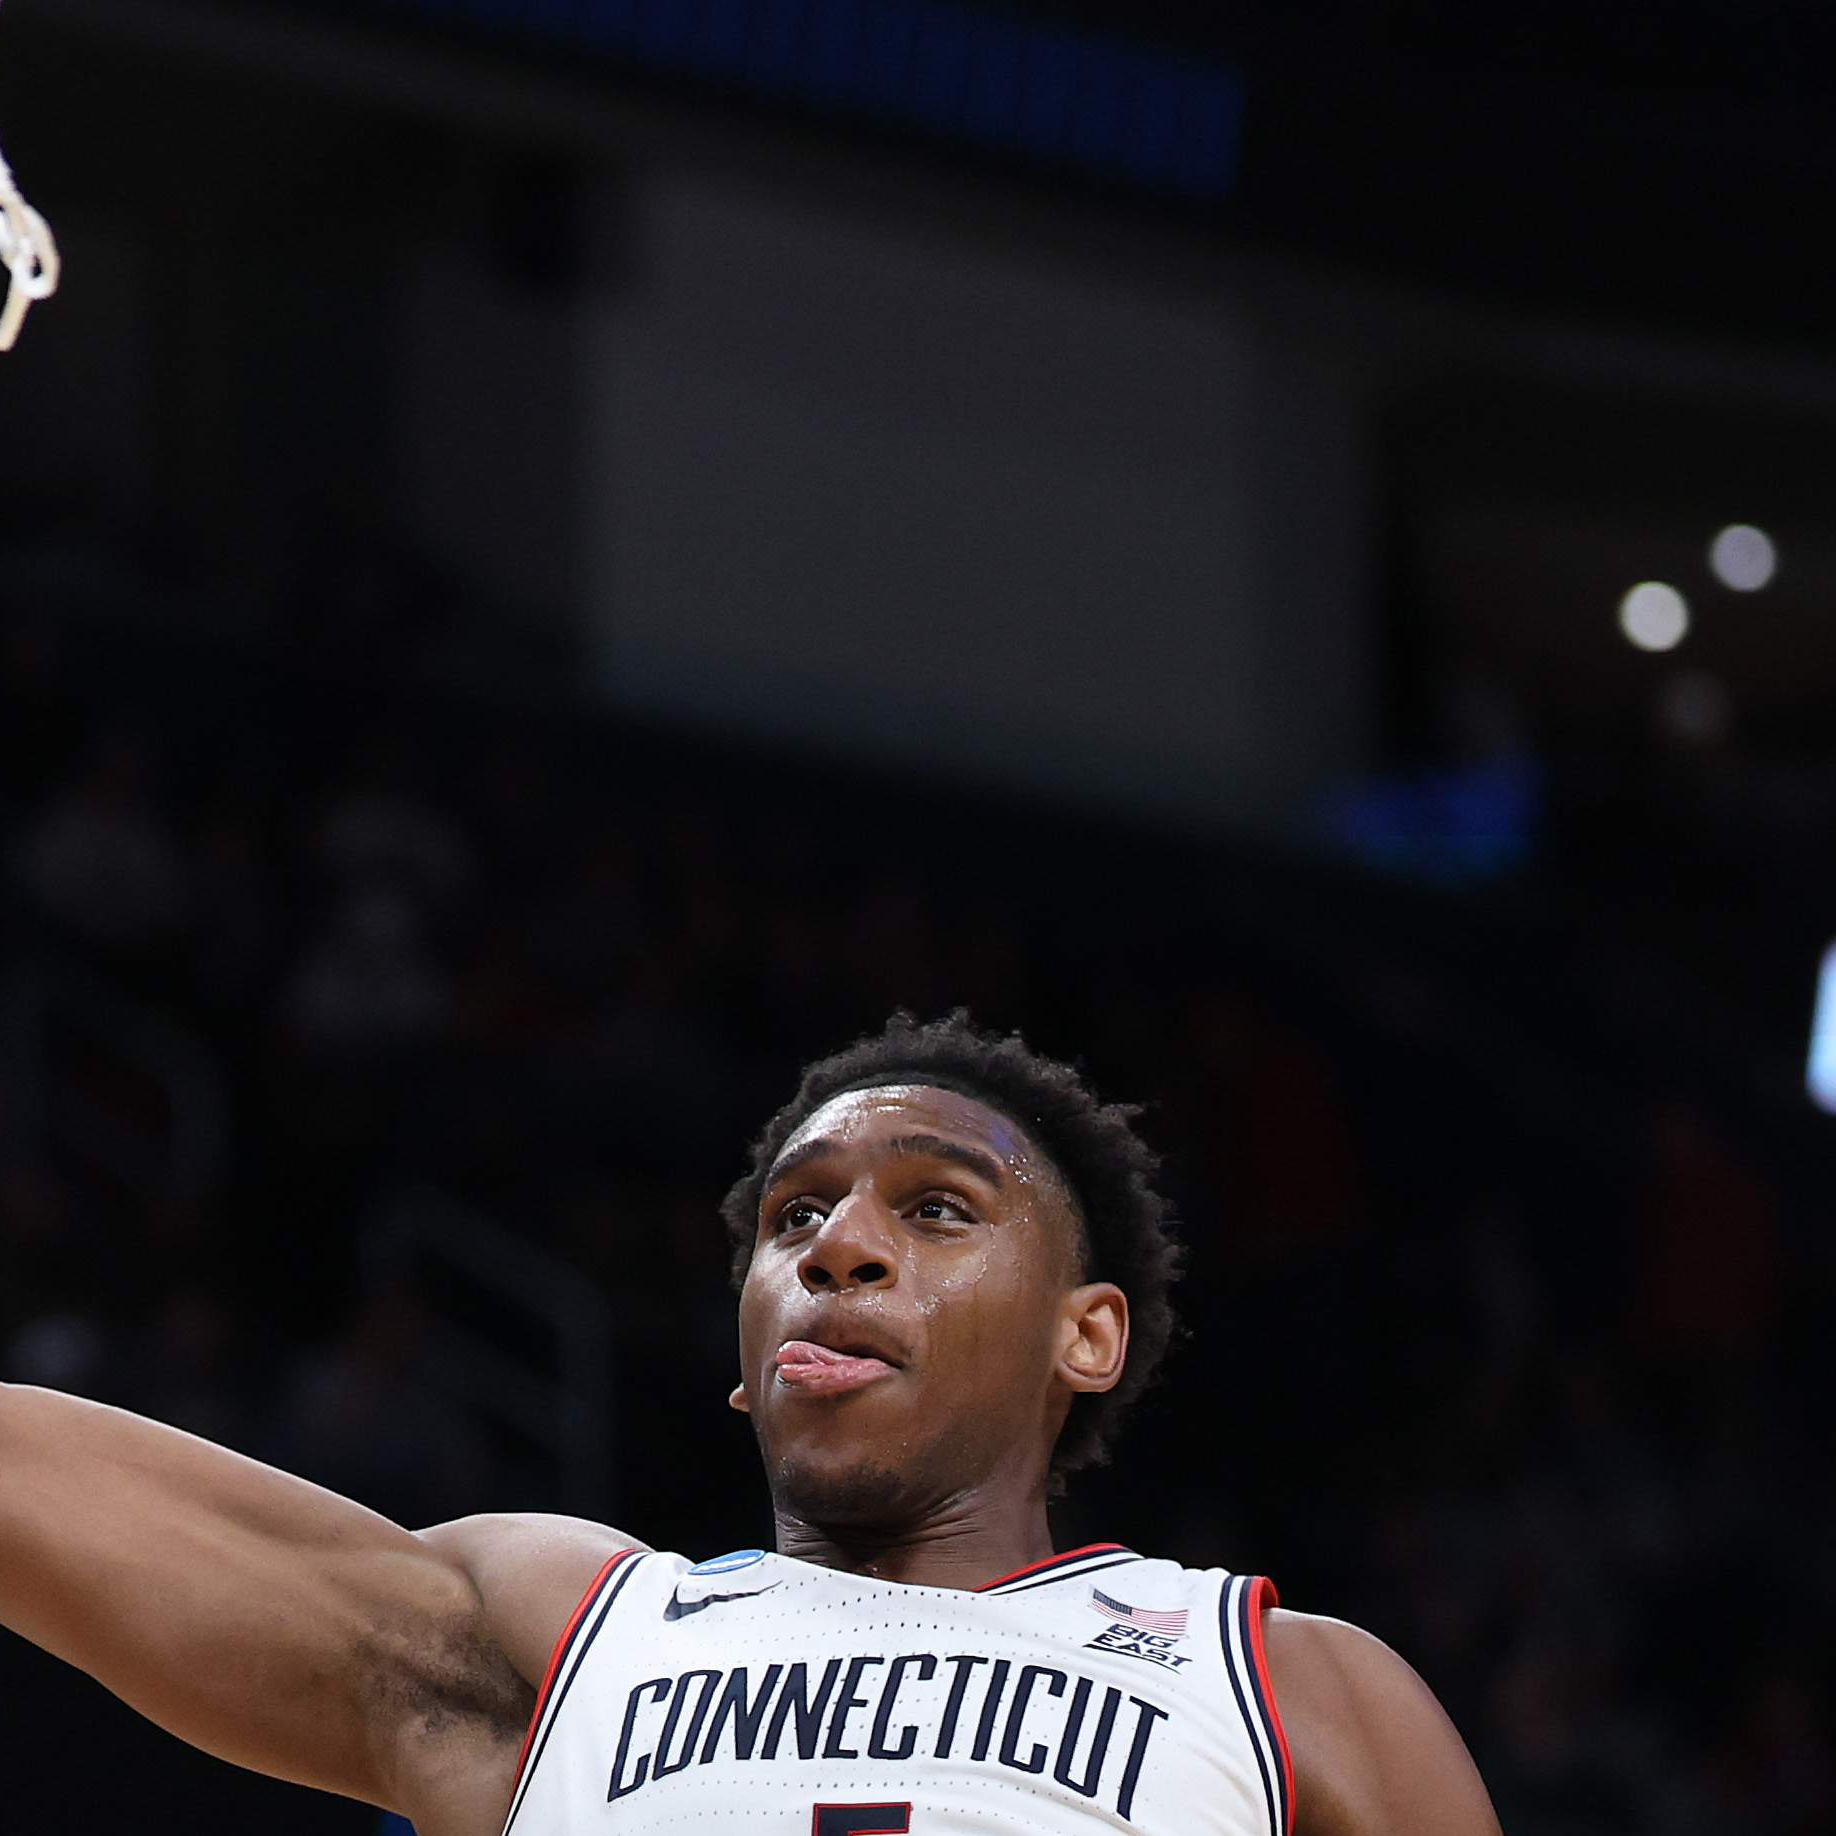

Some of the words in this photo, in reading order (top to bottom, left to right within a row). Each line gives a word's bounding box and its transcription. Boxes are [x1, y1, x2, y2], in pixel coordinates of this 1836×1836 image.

[1092, 1633, 1193, 1667] EAST
[1106, 1623, 1180, 1649] BIG
[607, 1652, 1170, 1823] CONNECTICUT
